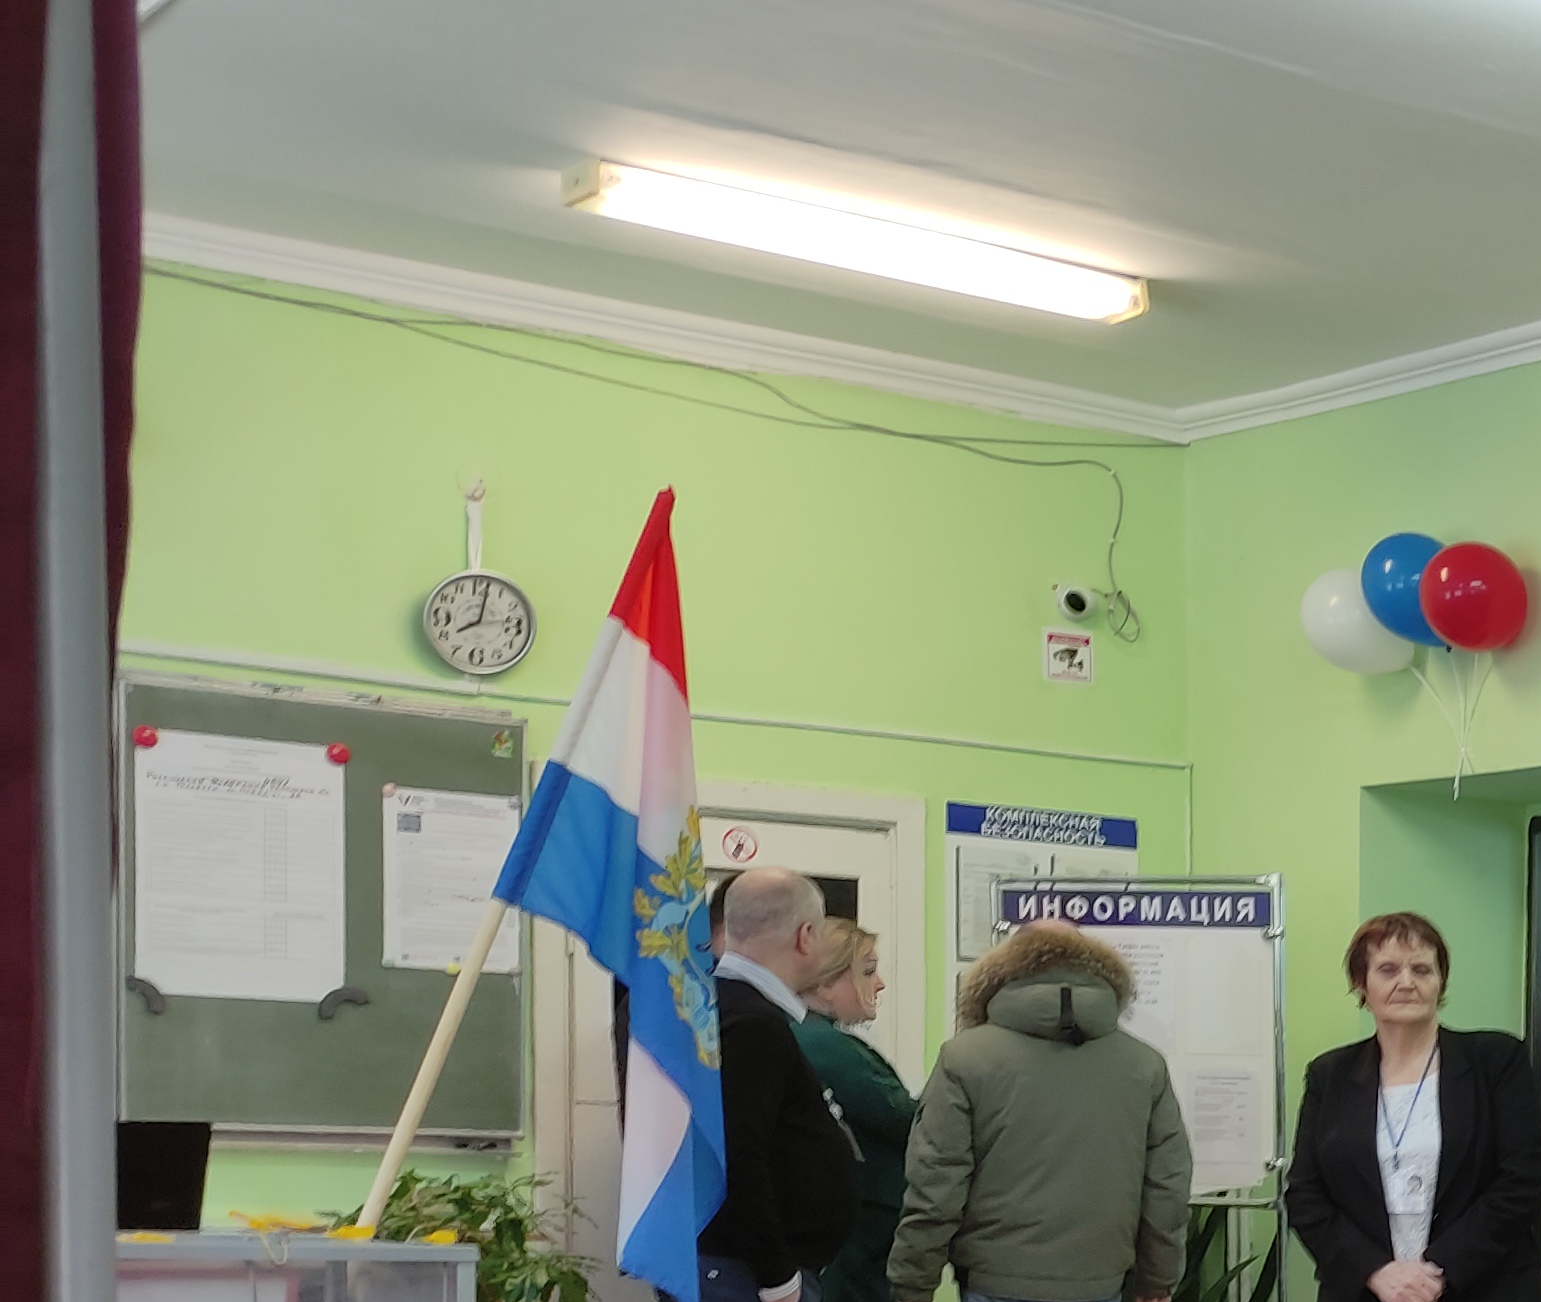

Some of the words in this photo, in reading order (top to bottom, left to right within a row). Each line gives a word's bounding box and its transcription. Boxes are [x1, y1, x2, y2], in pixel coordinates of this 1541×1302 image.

[986, 806, 1103, 830] КОМПЛЕКСНАЯ
[981, 821, 1106, 846] БЕЗОПАСНОСТЬ
[1017, 893, 1256, 927] ИНФОРМАЦИЯ
